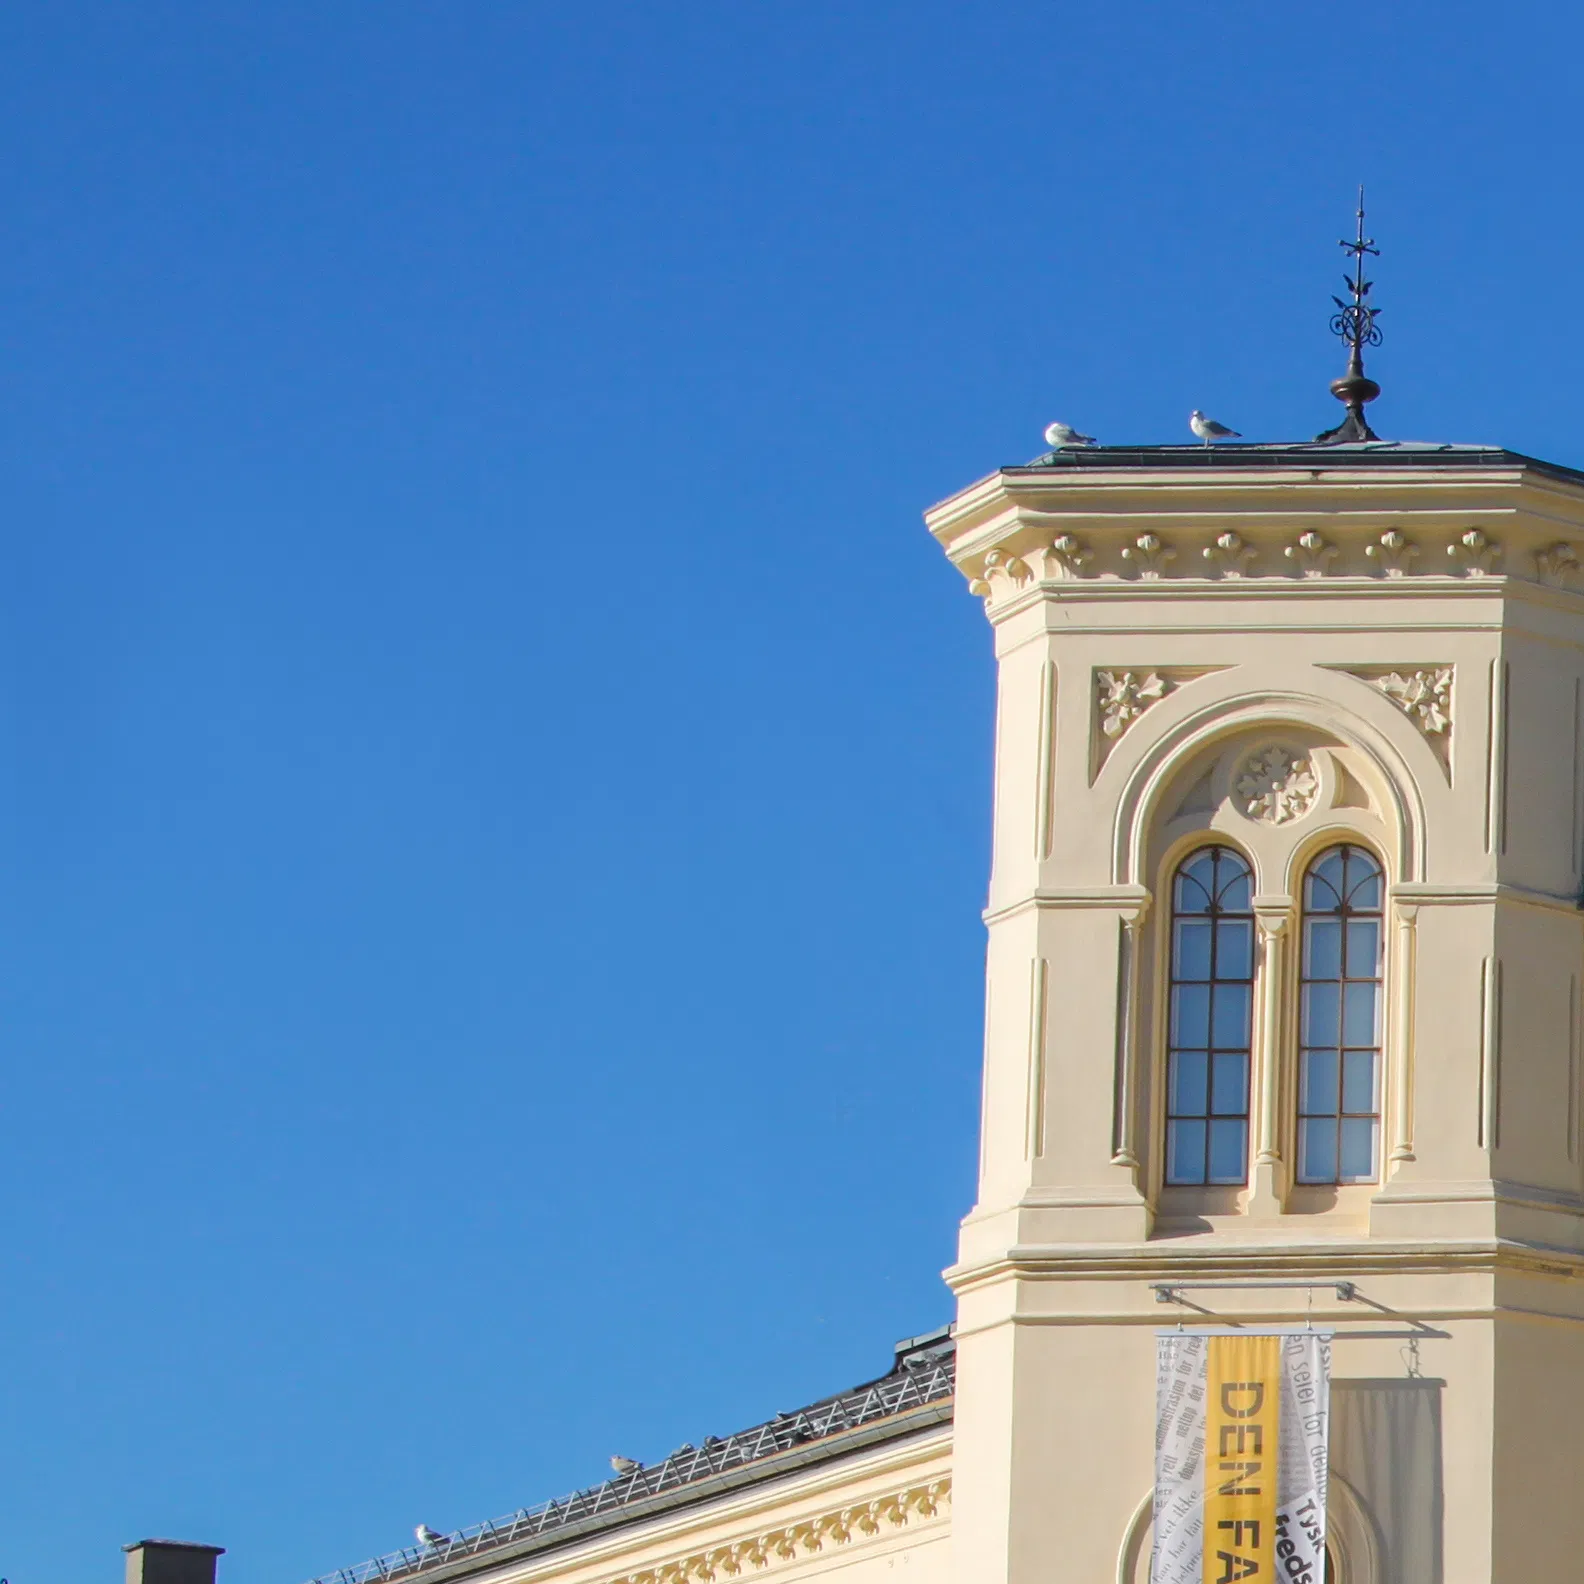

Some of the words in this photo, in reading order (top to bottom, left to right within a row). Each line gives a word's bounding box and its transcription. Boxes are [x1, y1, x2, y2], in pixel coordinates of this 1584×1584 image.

[1291, 1362, 1318, 1405] seier
[1218, 1382, 1264, 1496] DEN
[1302, 1411, 1327, 1437] for
[1295, 1498, 1325, 1555] Tysk
